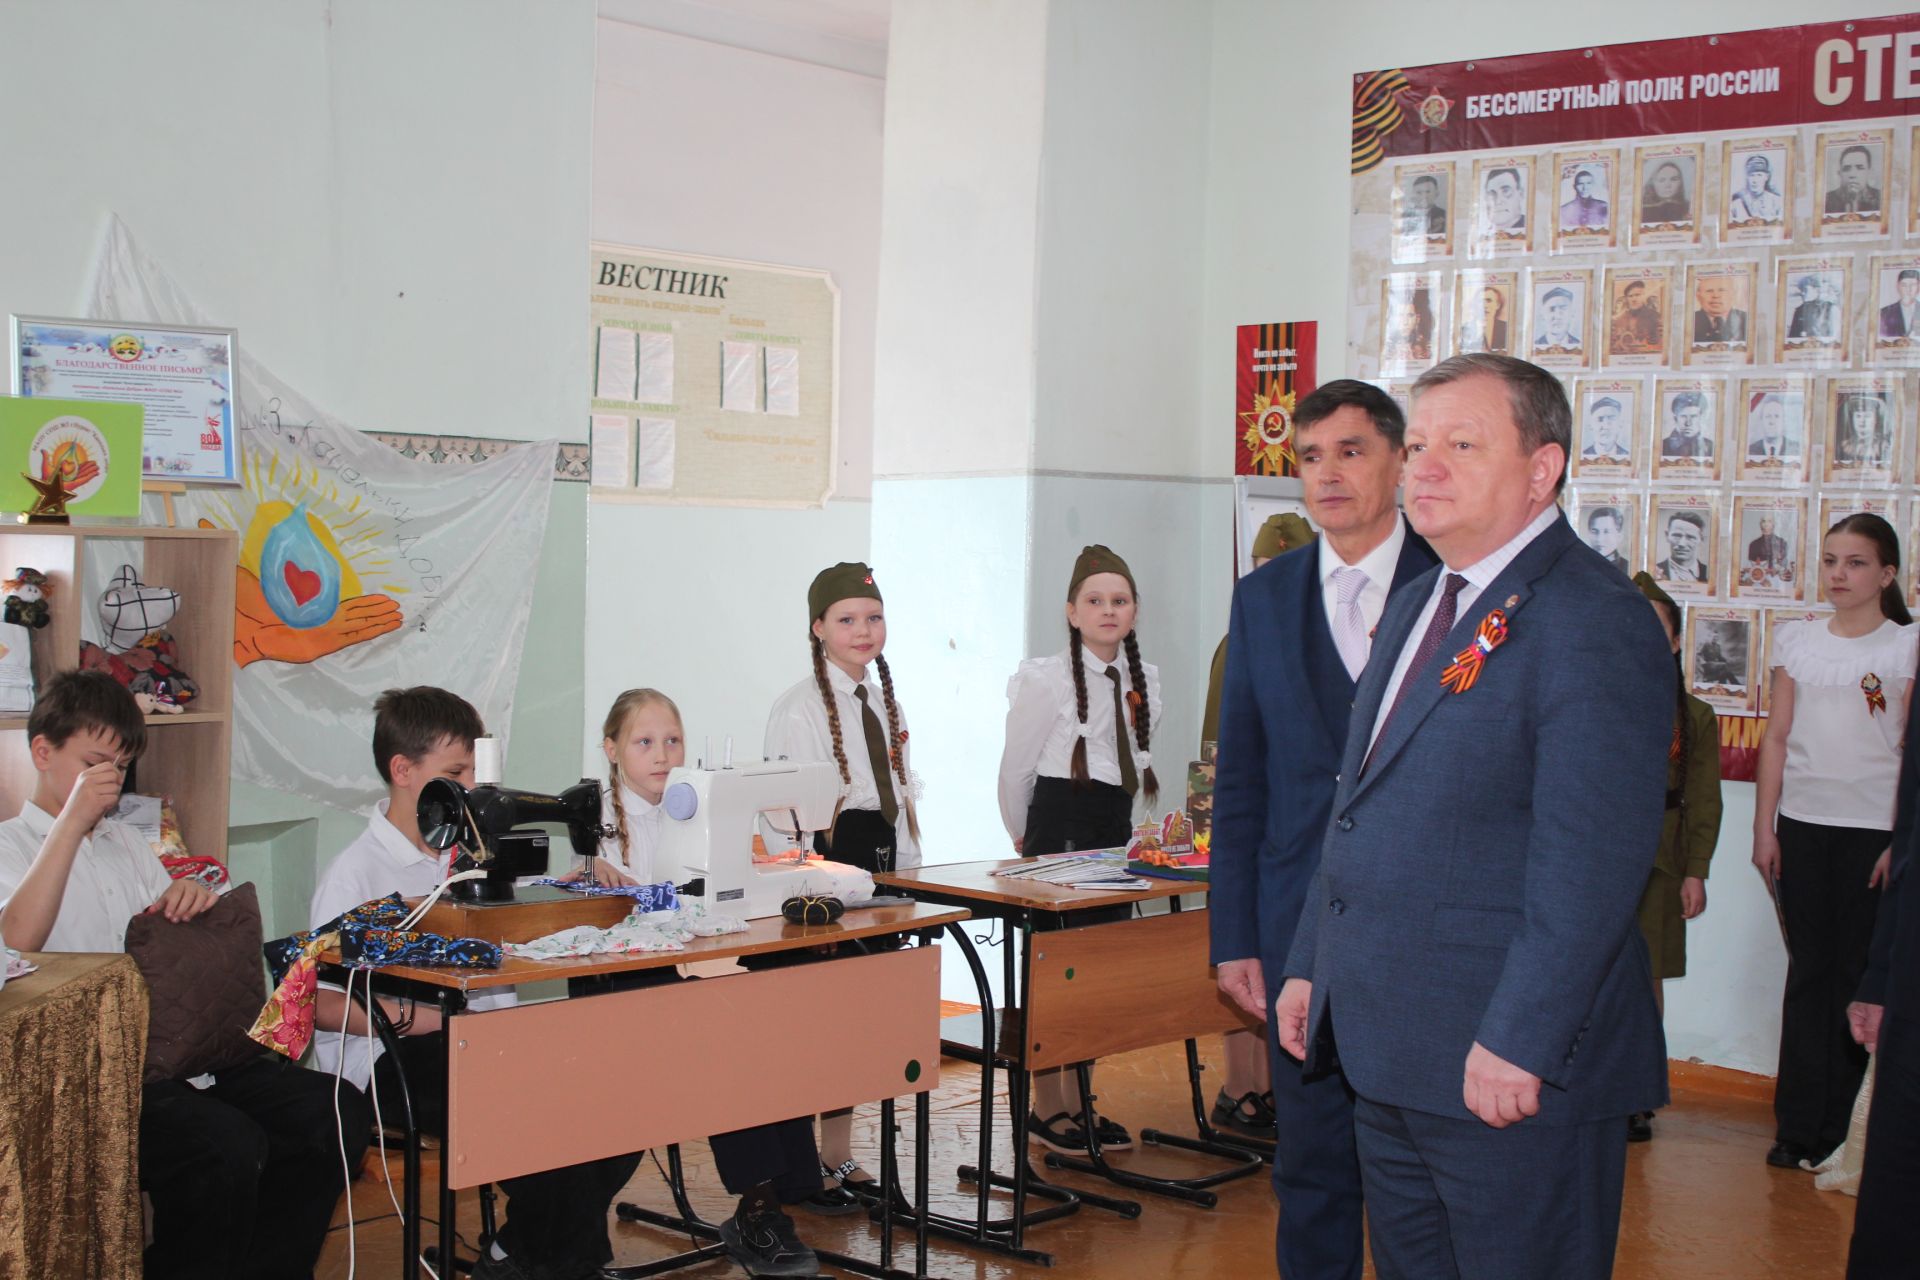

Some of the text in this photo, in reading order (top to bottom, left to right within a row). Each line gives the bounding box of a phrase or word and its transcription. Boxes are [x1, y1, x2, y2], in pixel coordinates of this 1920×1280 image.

[1814, 31, 1920, 106] СТЕ
[1466, 67, 1780, 119] БЕССМЕРТНЫЙ ПОЛК РОССИИ
[596, 261, 729, 299] ВЕСТНИК
[55, 360, 203, 375] БЛАГОДАРСТВЕННОЕ ПИСЬМО
